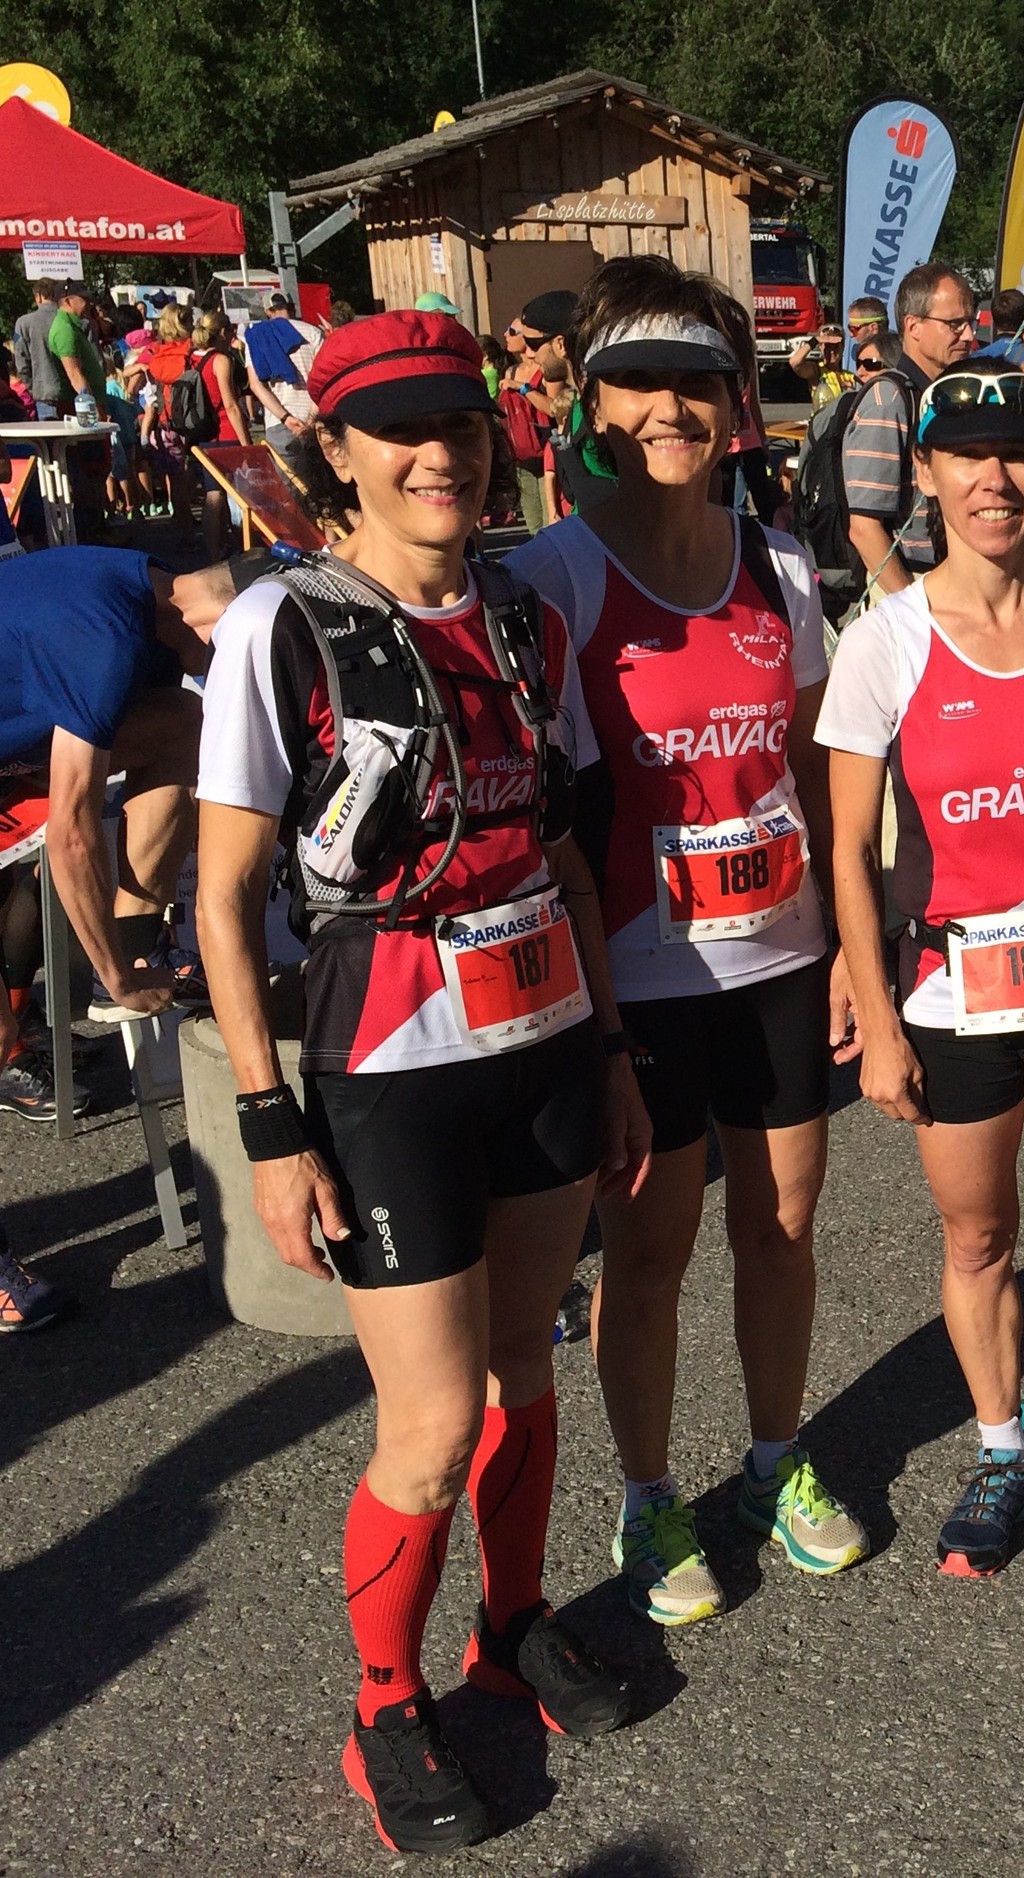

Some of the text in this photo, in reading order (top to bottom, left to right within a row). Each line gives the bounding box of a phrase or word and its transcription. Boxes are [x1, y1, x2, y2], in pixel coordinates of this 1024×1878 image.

[0, 216, 185, 241] montafon.at
[864, 159, 918, 303] RKASSE
[709, 703, 768, 719] erdgas
[480, 755, 535, 773] erdgas
[632, 718, 788, 768] GRAVAG
[320, 767, 364, 855] SALOM
[421, 774, 535, 820] RAVA
[664, 829, 757, 853] SPARKASSE
[715, 848, 770, 896] 188
[451, 914, 540, 949] SPARKASSE
[509, 934, 549, 991] 187
